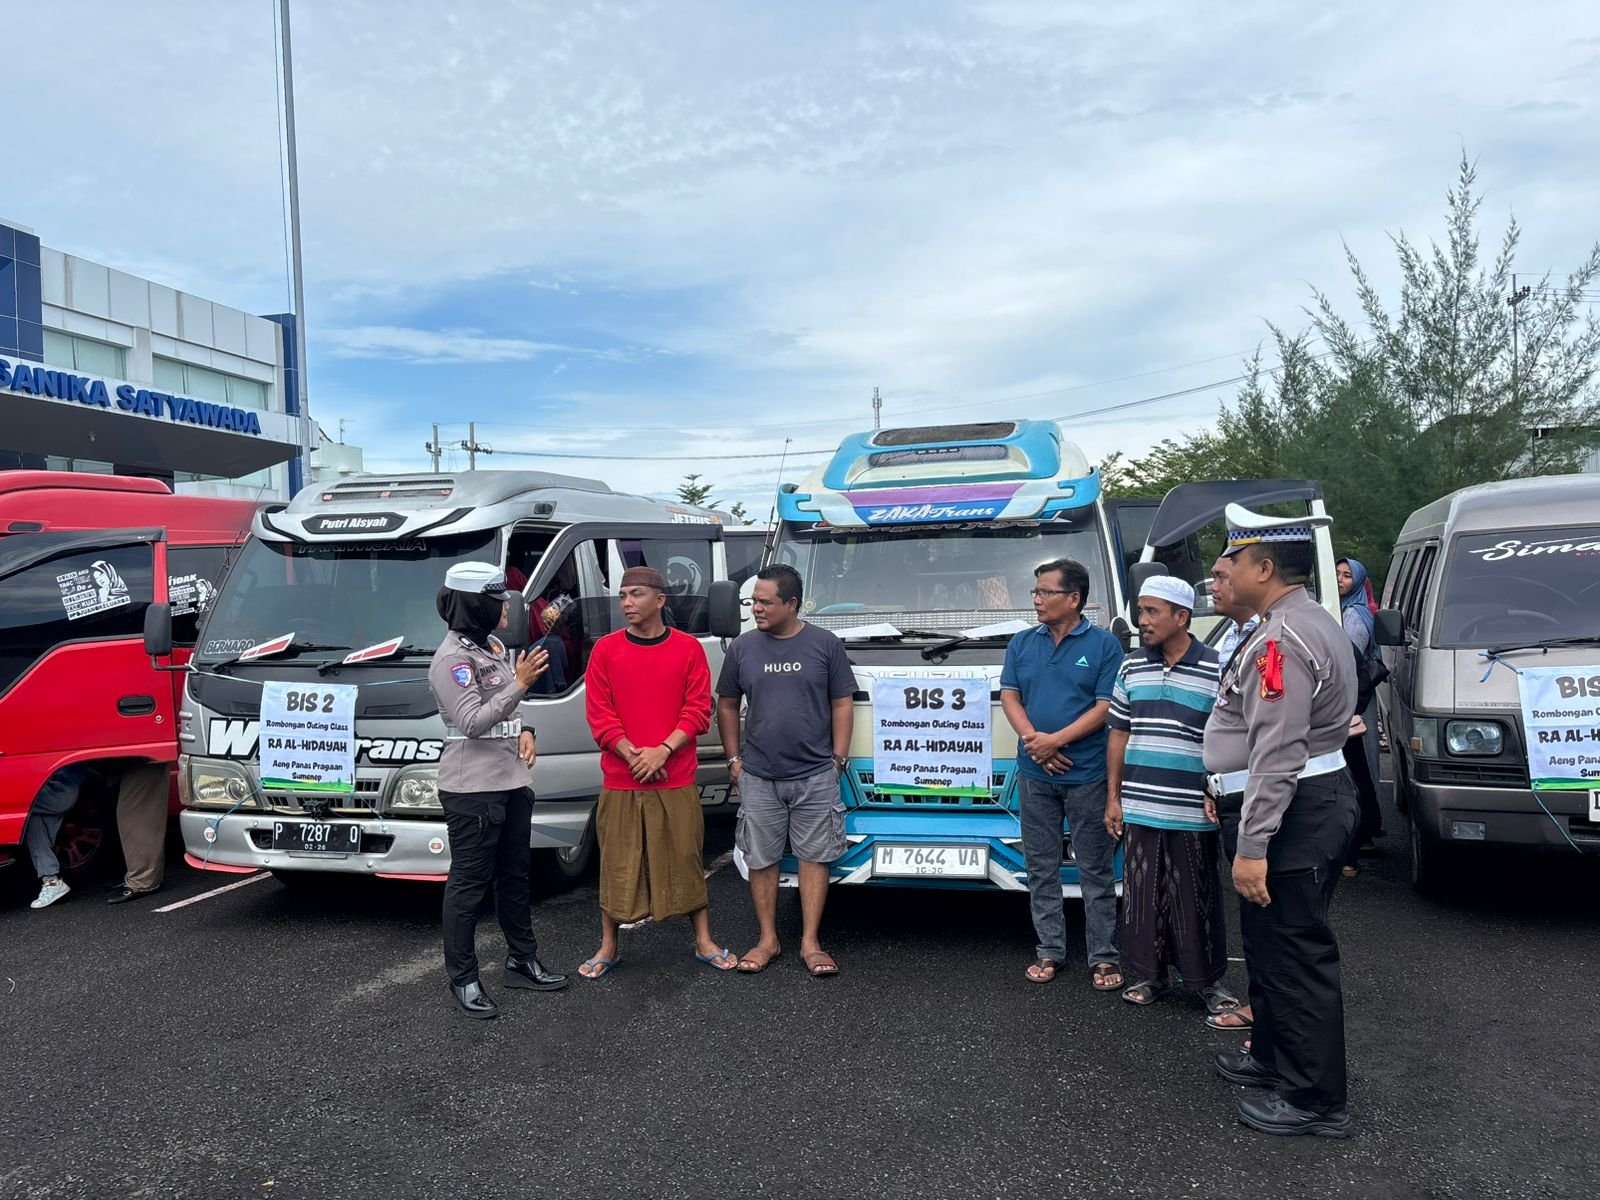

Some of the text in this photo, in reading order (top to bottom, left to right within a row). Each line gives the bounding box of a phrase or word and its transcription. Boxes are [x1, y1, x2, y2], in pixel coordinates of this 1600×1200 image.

[0, 359, 261, 435] SANIKA SATYAWADA
[867, 505, 996, 520] ZAKA Trans
[320, 517, 388, 529] Putri Aisyah
[764, 661, 802, 673] HUGO
[1555, 676, 1600, 699] BIS
[286, 691, 335, 713] BIS 2
[904, 686, 966, 711] BIS 3
[1532, 708, 1594, 719] Rombongan
[266, 719, 348, 731] Rombongan Outing Class
[880, 719, 985, 730] Rombongan Outing Class
[208, 718, 443, 761] W rans
[1538, 731, 1561, 744] RA
[268, 738, 347, 753] RA AL-HIDAYAH
[883, 739, 983, 754] RA AL-HIDAYAH
[272, 760, 343, 772] Aeng Panas Pragaan
[1549, 756, 1576, 766] Aeng
[890, 763, 977, 775] Aeng Panas Pragaan
[292, 772, 322, 782] Sumenep
[914, 776, 953, 787] Sumenep
[275, 823, 283, 841] P
[300, 823, 331, 842] 7287
[882, 848, 980, 866] M 7644 VA
